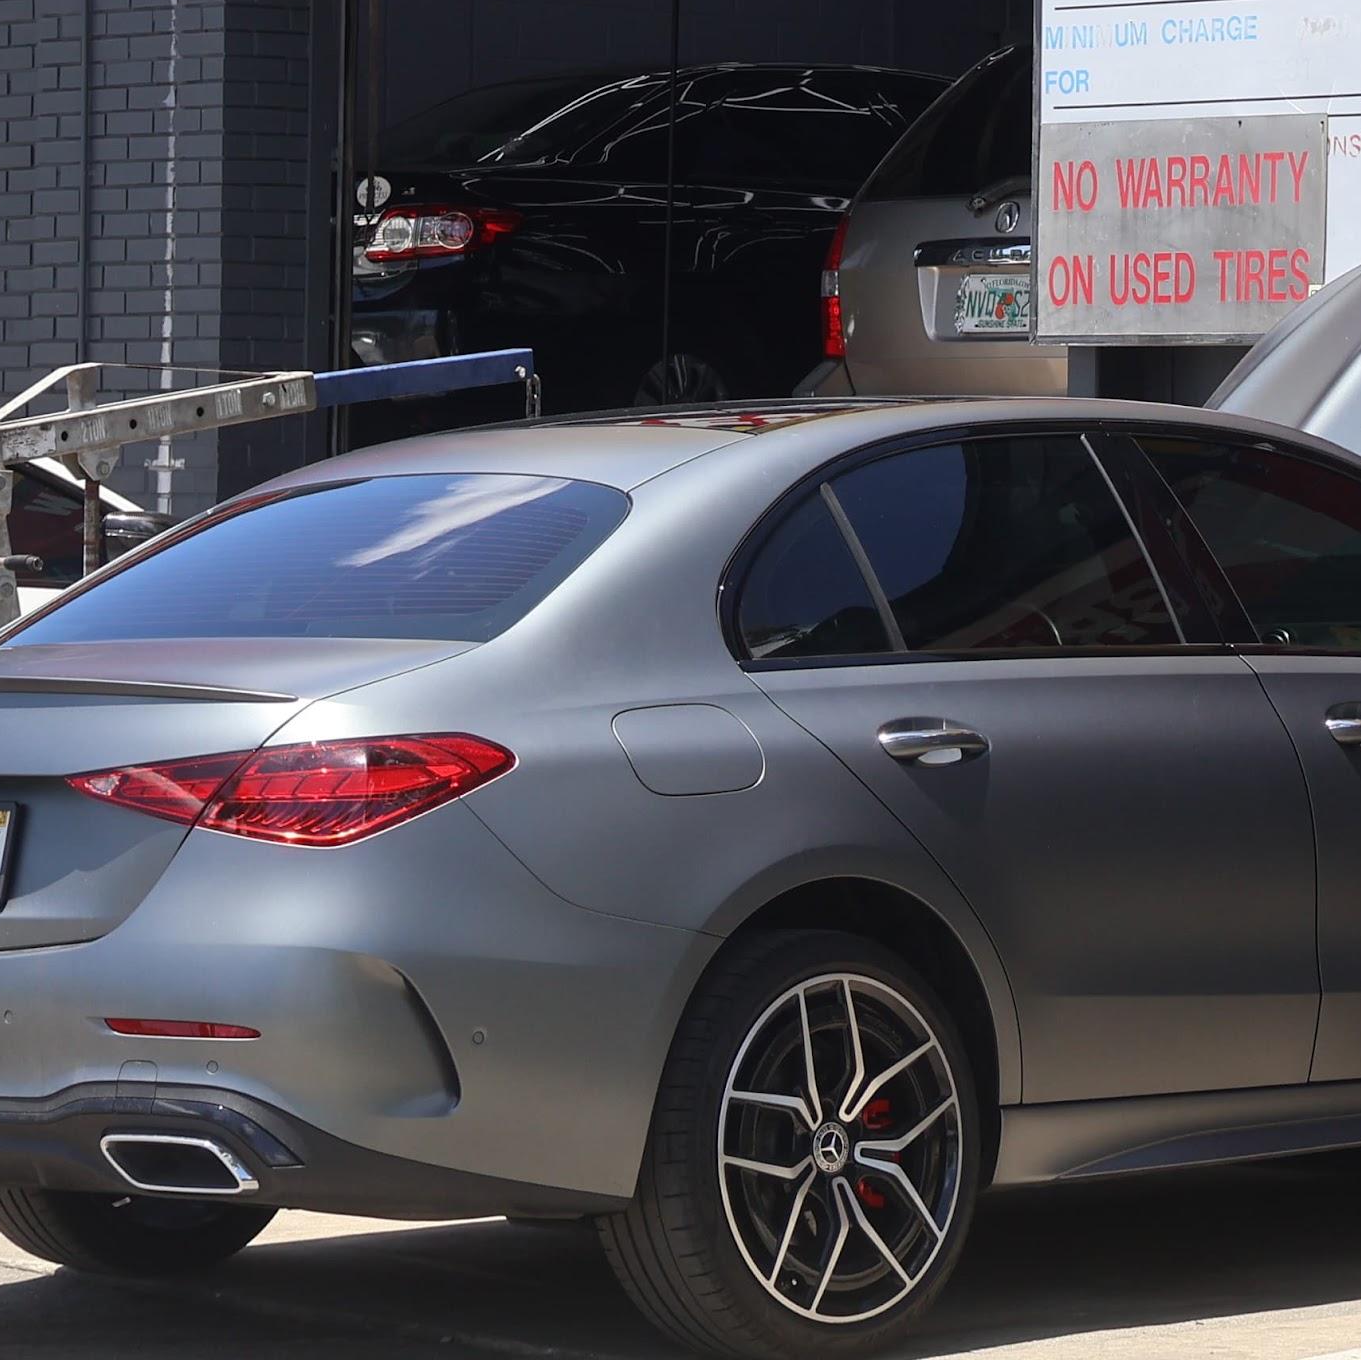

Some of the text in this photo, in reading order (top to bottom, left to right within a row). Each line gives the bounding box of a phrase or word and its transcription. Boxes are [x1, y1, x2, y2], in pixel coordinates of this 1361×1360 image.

[1161, 15, 1258, 46] CHARGE
[1045, 69, 1090, 94] FOR
[1051, 151, 1309, 211] NO WARRANTY
[1048, 246, 1311, 307] ON USED TIRES
